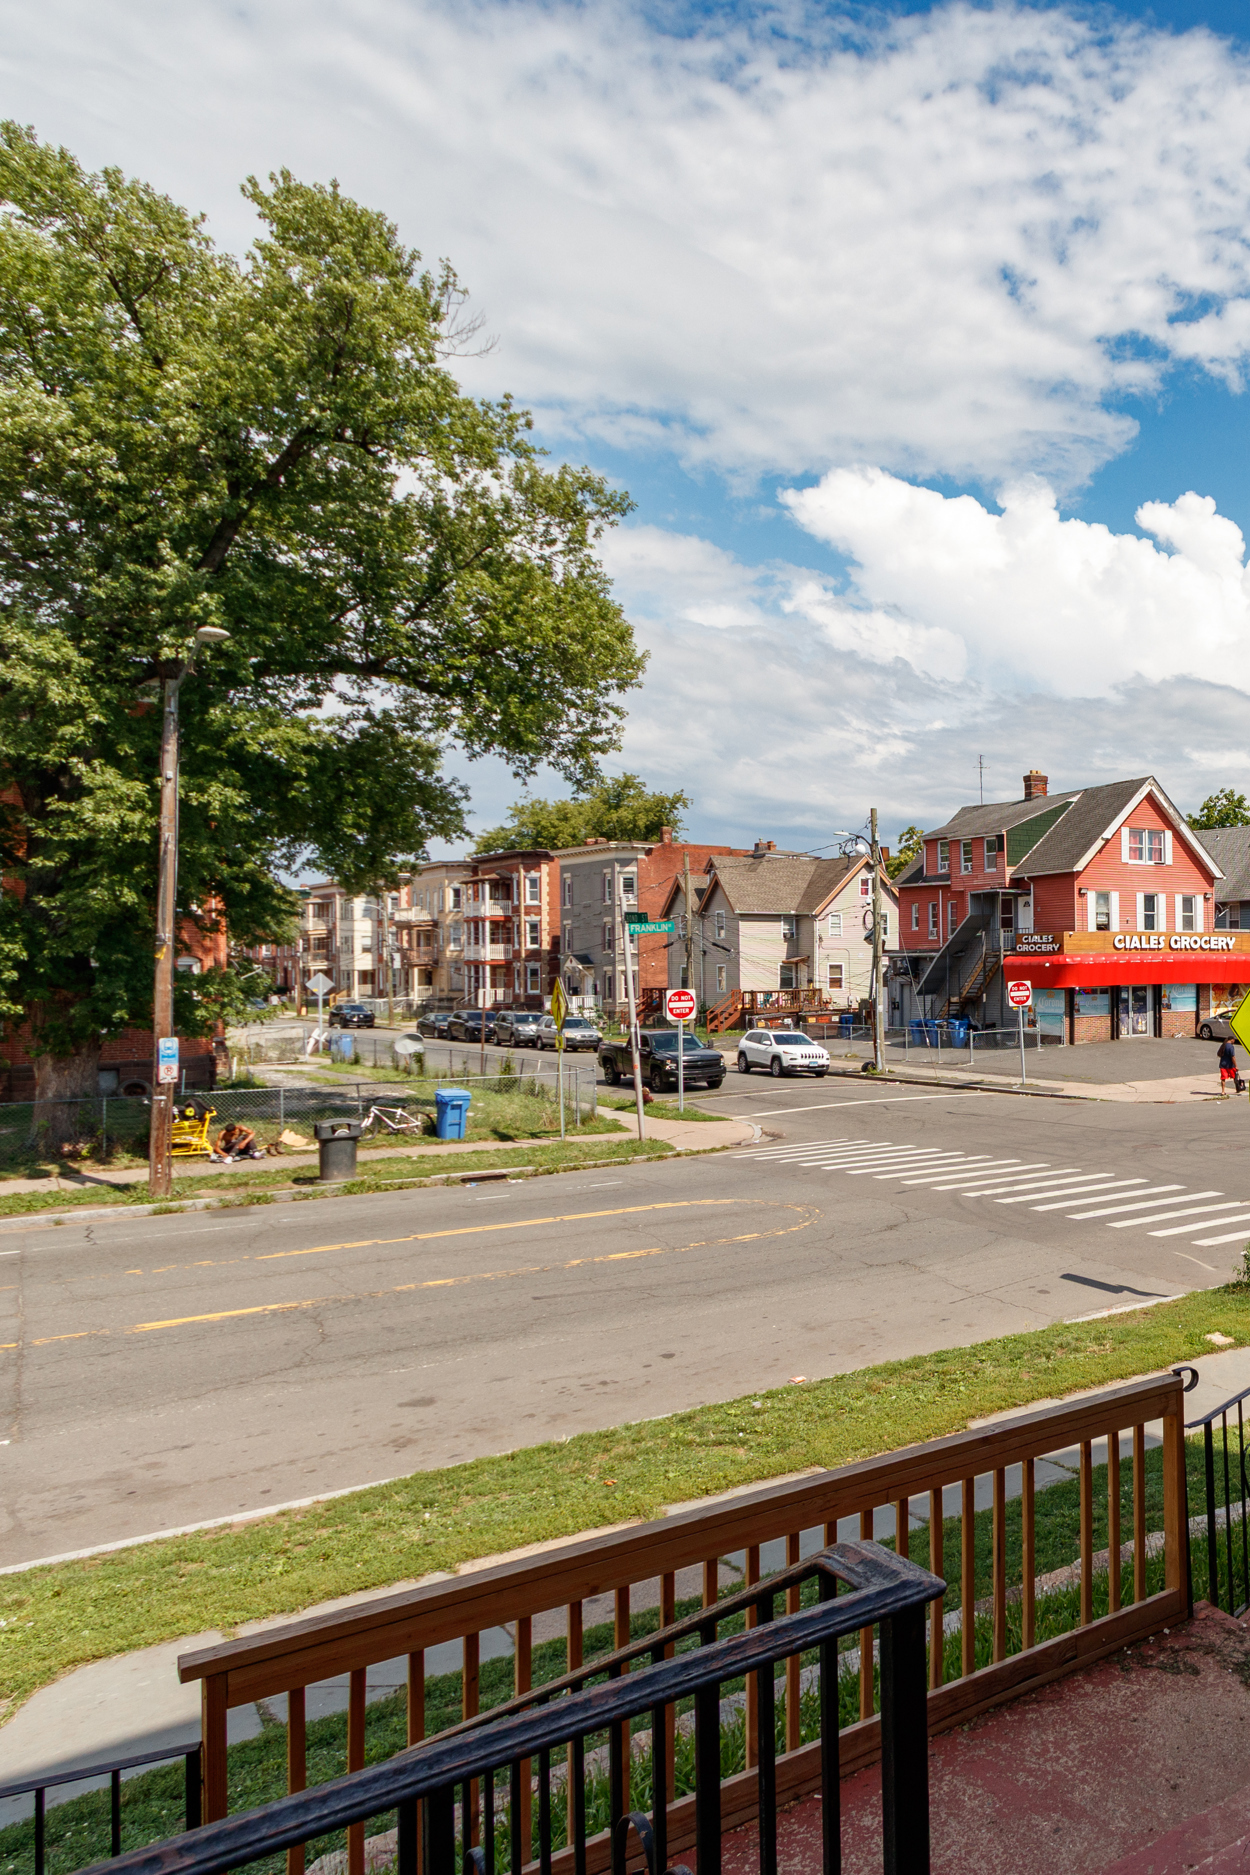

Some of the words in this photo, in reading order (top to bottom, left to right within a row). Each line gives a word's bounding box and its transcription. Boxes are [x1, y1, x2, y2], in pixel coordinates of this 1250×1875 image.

[630, 923, 668, 933] FRANKLIN
[1022, 935, 1054, 943] CIALES
[1113, 935, 1165, 949] CIALES
[1169, 935, 1236, 950] GROCERY
[1016, 943, 1060, 952] GROCERY
